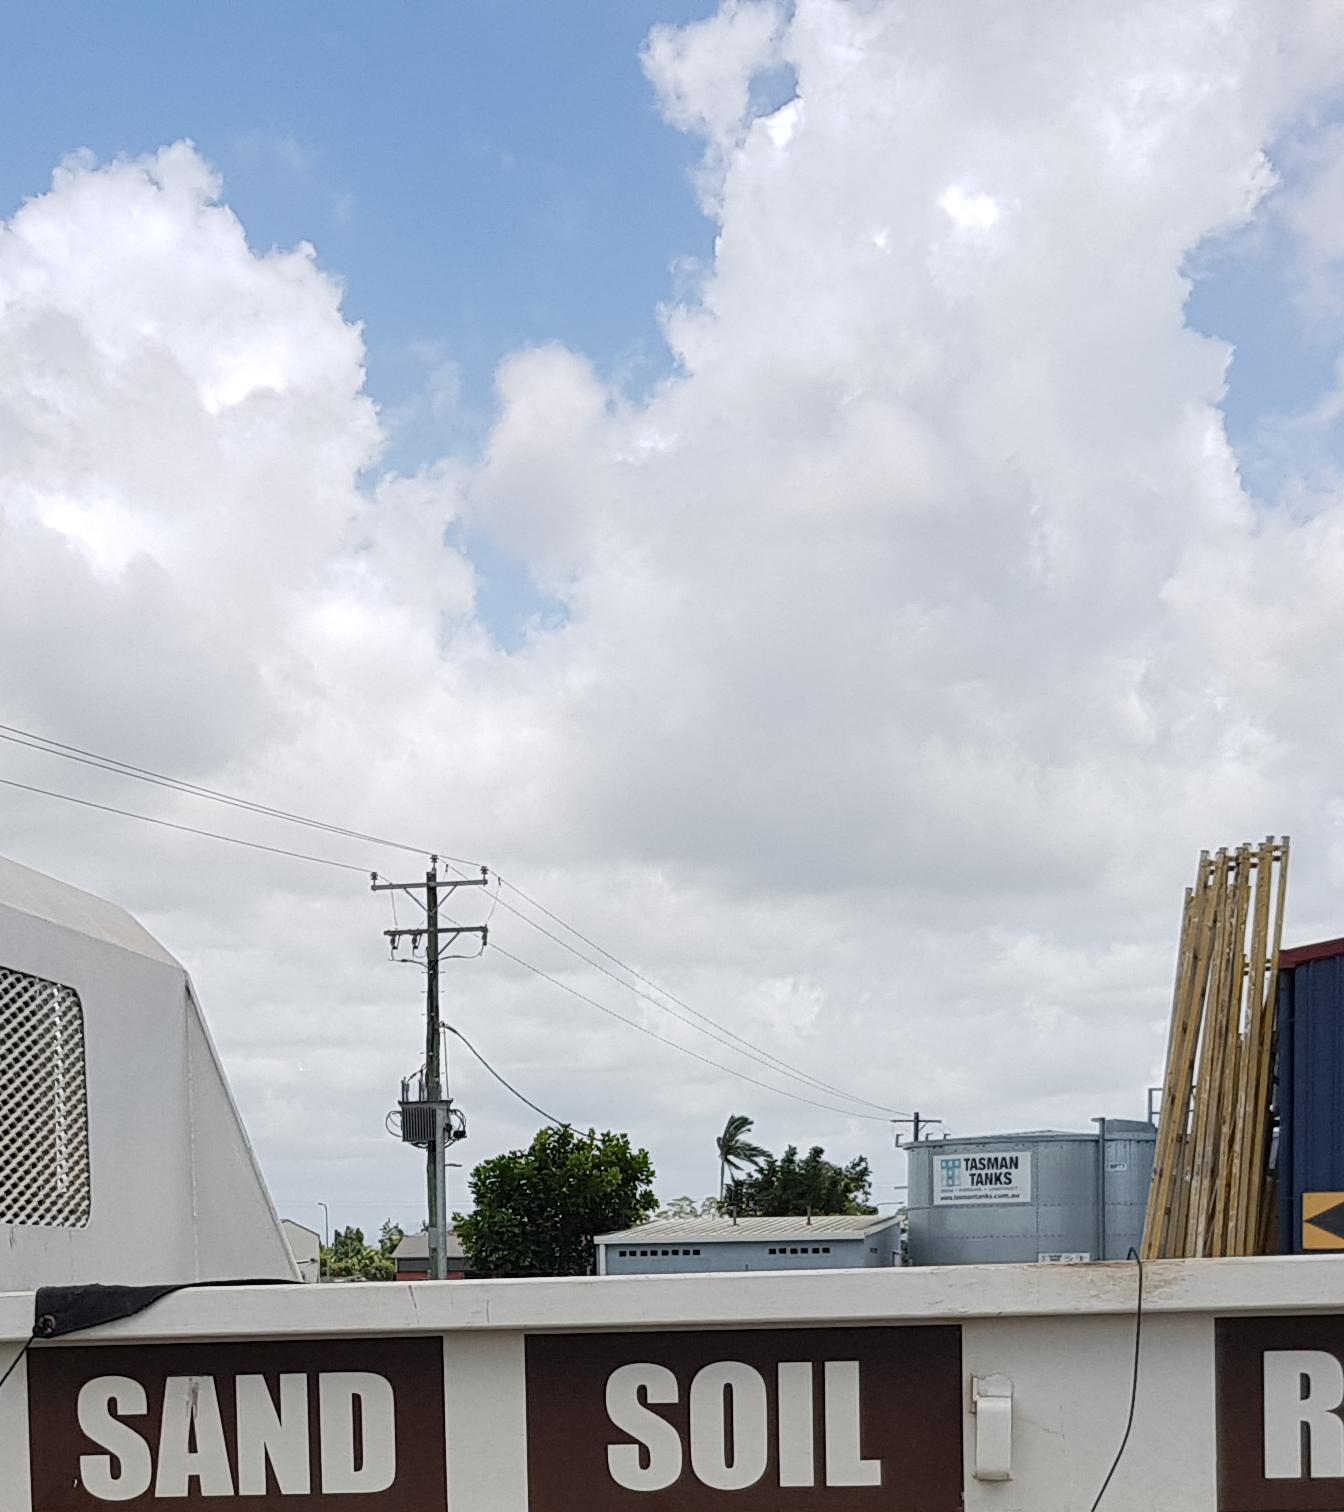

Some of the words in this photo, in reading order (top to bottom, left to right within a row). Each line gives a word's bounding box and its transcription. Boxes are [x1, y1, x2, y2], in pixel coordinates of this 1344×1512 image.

[964, 1156, 1019, 1171] TASMAN
[969, 1172, 1013, 1186] TANKS
[76, 1372, 397, 1501] SAND
[605, 1360, 882, 1492] SOIL
